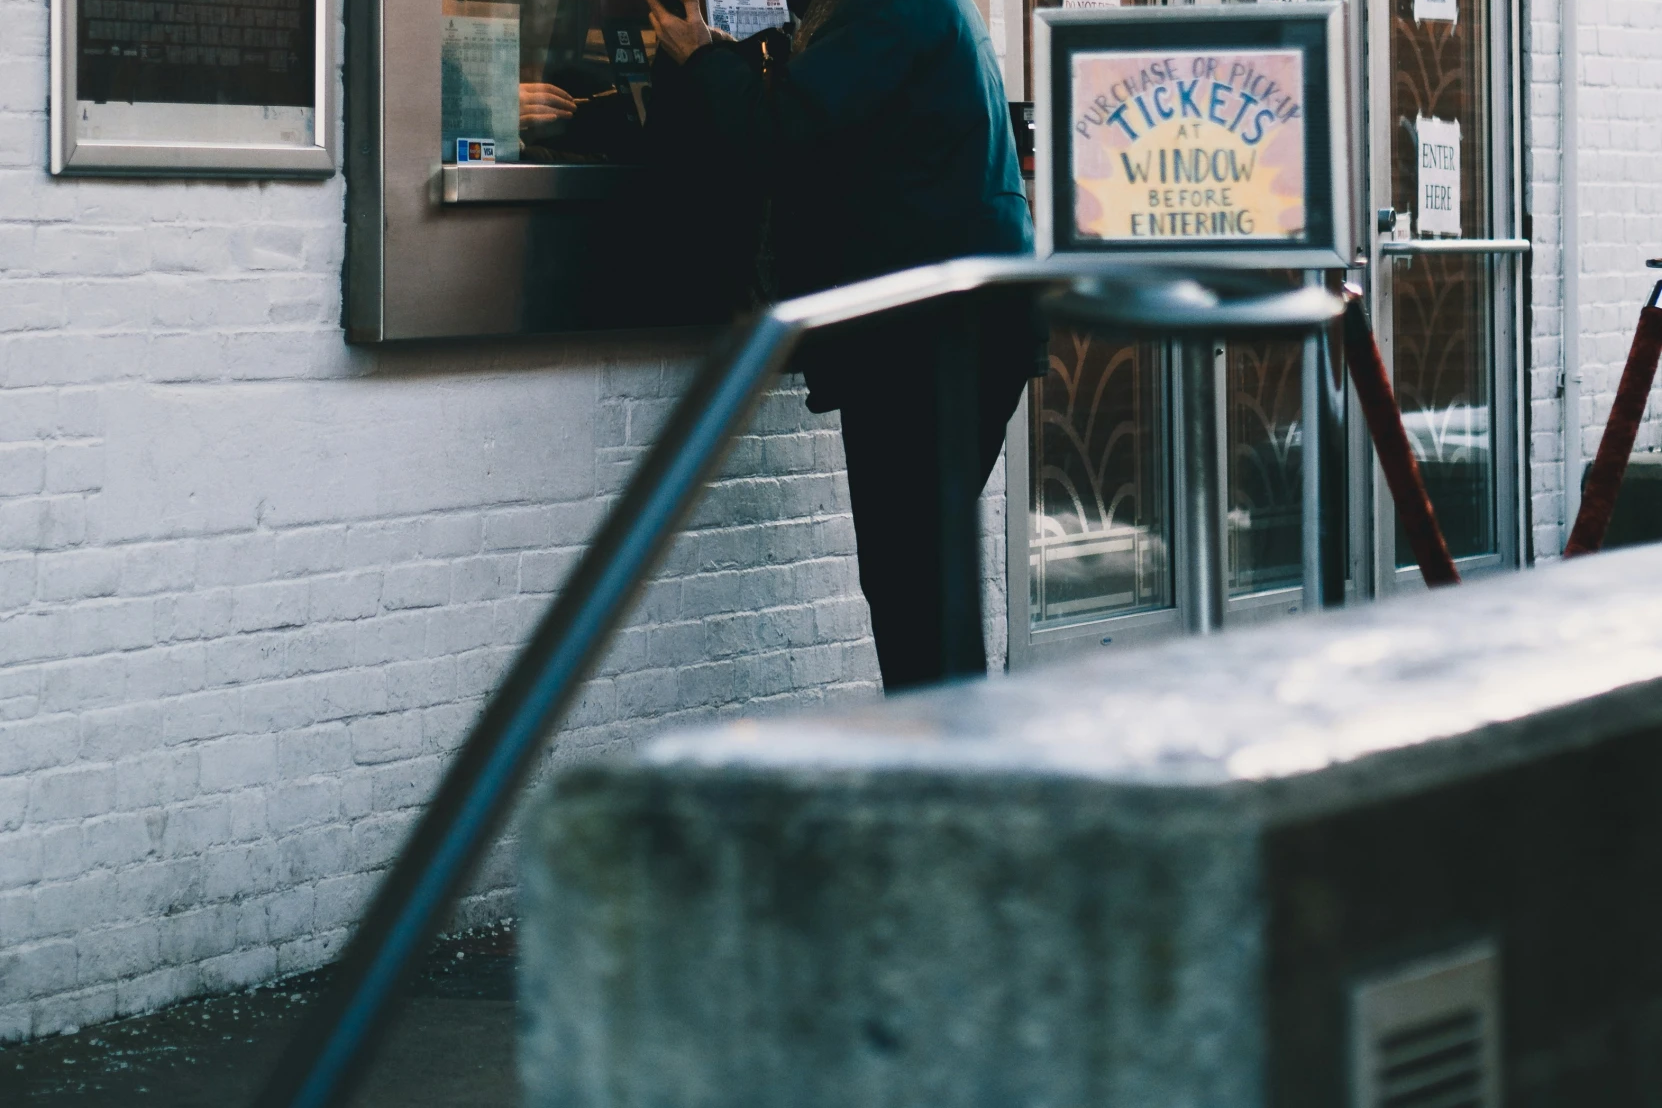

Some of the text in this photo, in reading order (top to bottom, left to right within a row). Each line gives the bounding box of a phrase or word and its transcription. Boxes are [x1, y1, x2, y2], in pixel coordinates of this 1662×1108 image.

[1076, 56, 1303, 140] PURCHASE OR PICK-UP
[1106, 80, 1277, 146] TICKETS
[1177, 123, 1201, 140] AT
[483, 147, 493, 156] VISA
[1423, 143, 1455, 171] ENTER
[1120, 148, 1256, 184] WINDOW
[1148, 188, 1233, 208] BEFORE
[1425, 184, 1452, 211] HERE
[1131, 210, 1255, 236] ENTERING
